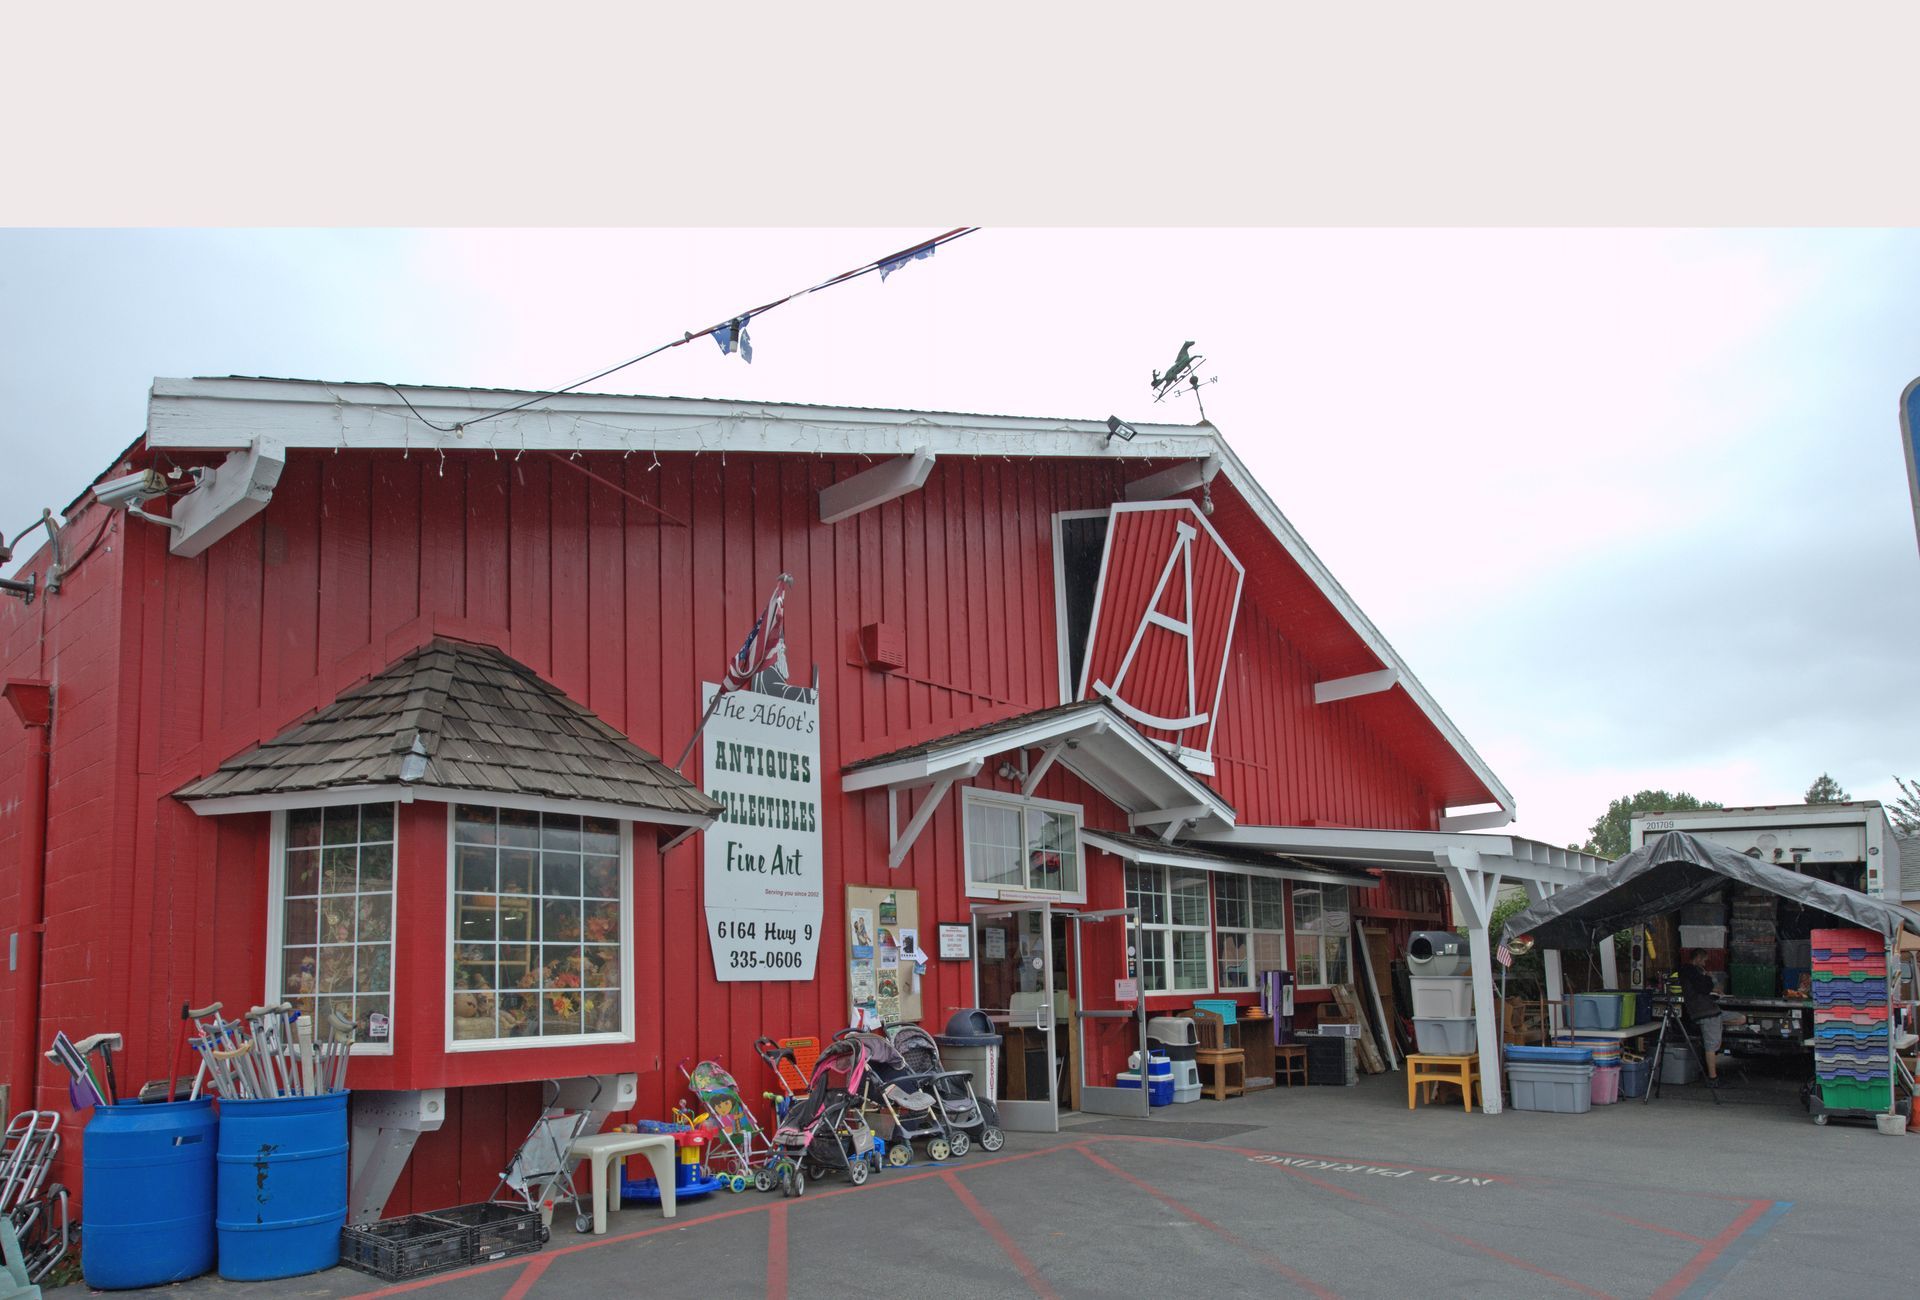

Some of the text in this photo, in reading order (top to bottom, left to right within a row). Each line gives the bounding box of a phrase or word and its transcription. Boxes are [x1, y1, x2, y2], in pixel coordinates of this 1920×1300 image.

[1093, 520, 1209, 730] A
[709, 695, 815, 734] The Abbot's
[715, 740, 811, 783] ANTIQUES
[1646, 821, 1675, 830] 201709
[727, 840, 803, 876] Fine Art
[765, 889, 784, 897] Serving
[718, 921, 813, 945] 6164 Hwy 9
[730, 950, 802, 969] 335-0606
[1248, 1154, 1494, 1187] NO PARKING
